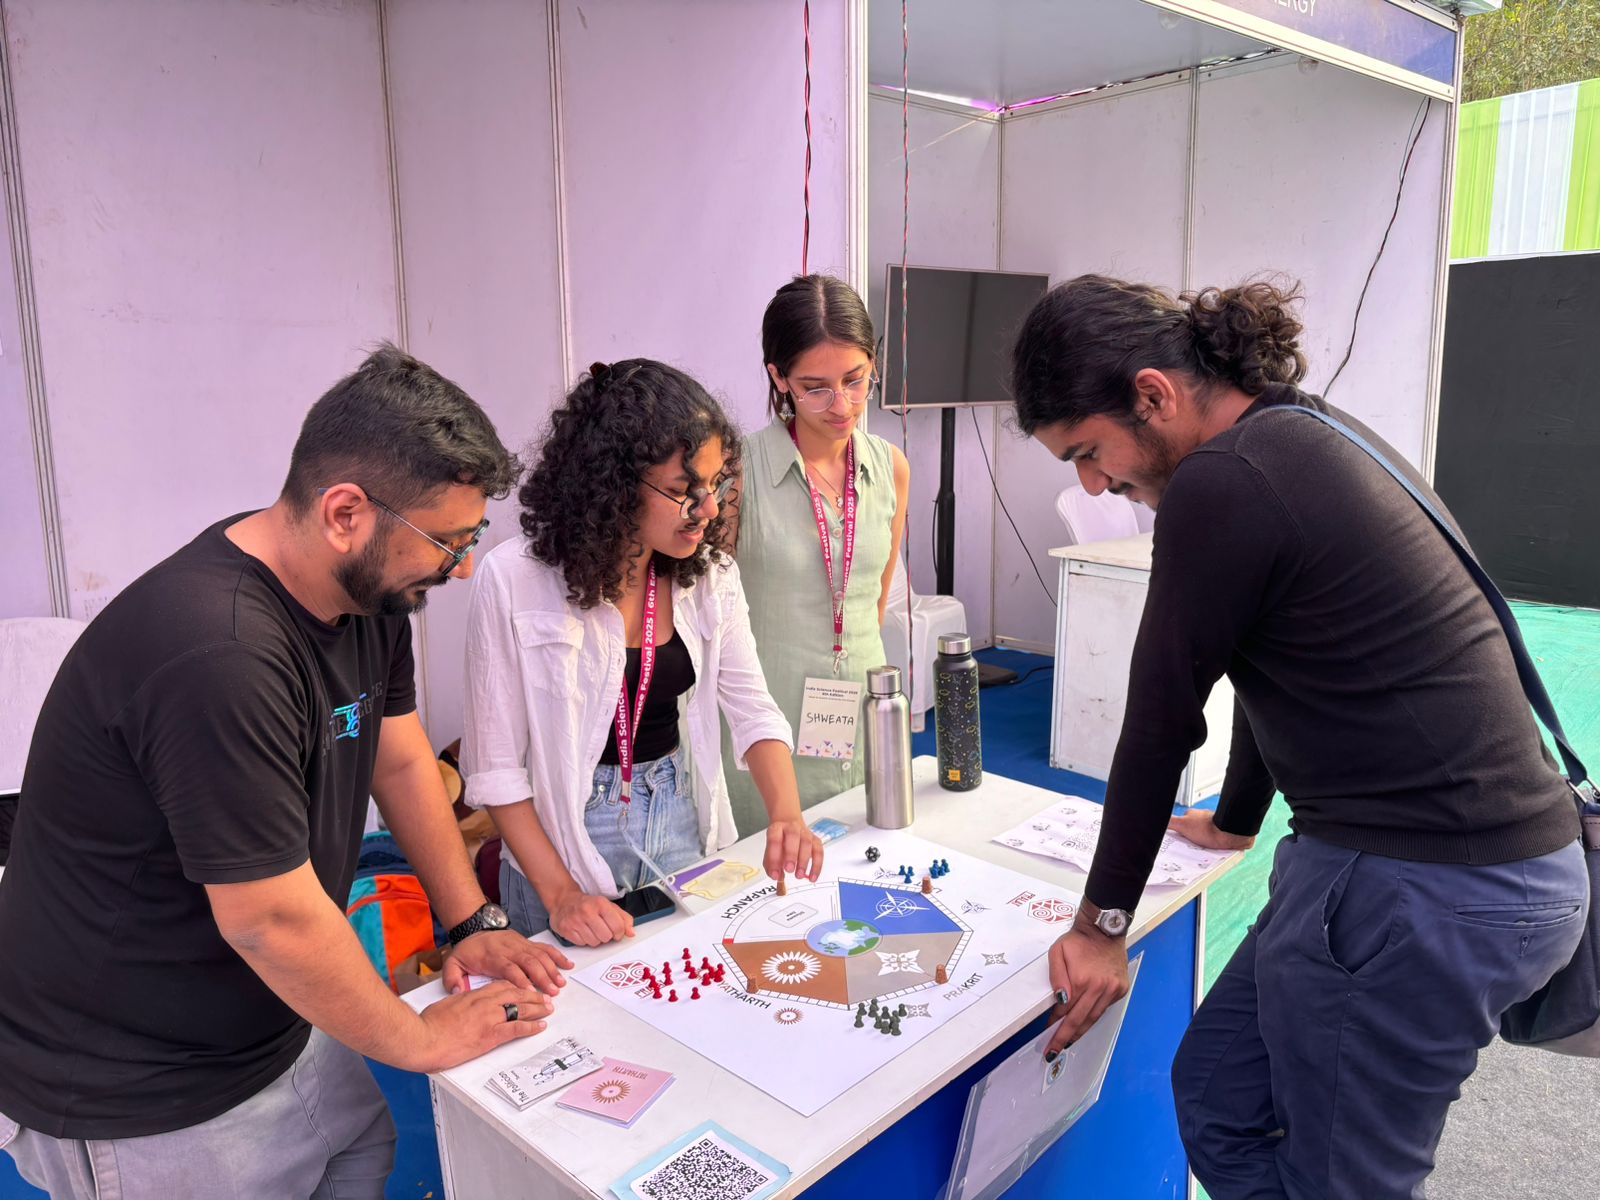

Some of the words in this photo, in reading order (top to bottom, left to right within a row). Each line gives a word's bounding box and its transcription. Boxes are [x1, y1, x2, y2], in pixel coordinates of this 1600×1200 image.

[813, 497, 823, 520] 2025
[819, 522, 830, 560] Festival
[845, 521, 853, 559] Festival
[647, 589, 655, 609] 6th
[644, 617, 654, 645] 2025
[639, 647, 653, 692] Festival
[806, 712, 855, 726] SHWEATA
[619, 739, 629, 769] India
[721, 885, 777, 919] RAPANCH
[943, 972, 984, 1001] PRAKRIT
[518, 1090, 530, 1103] The
